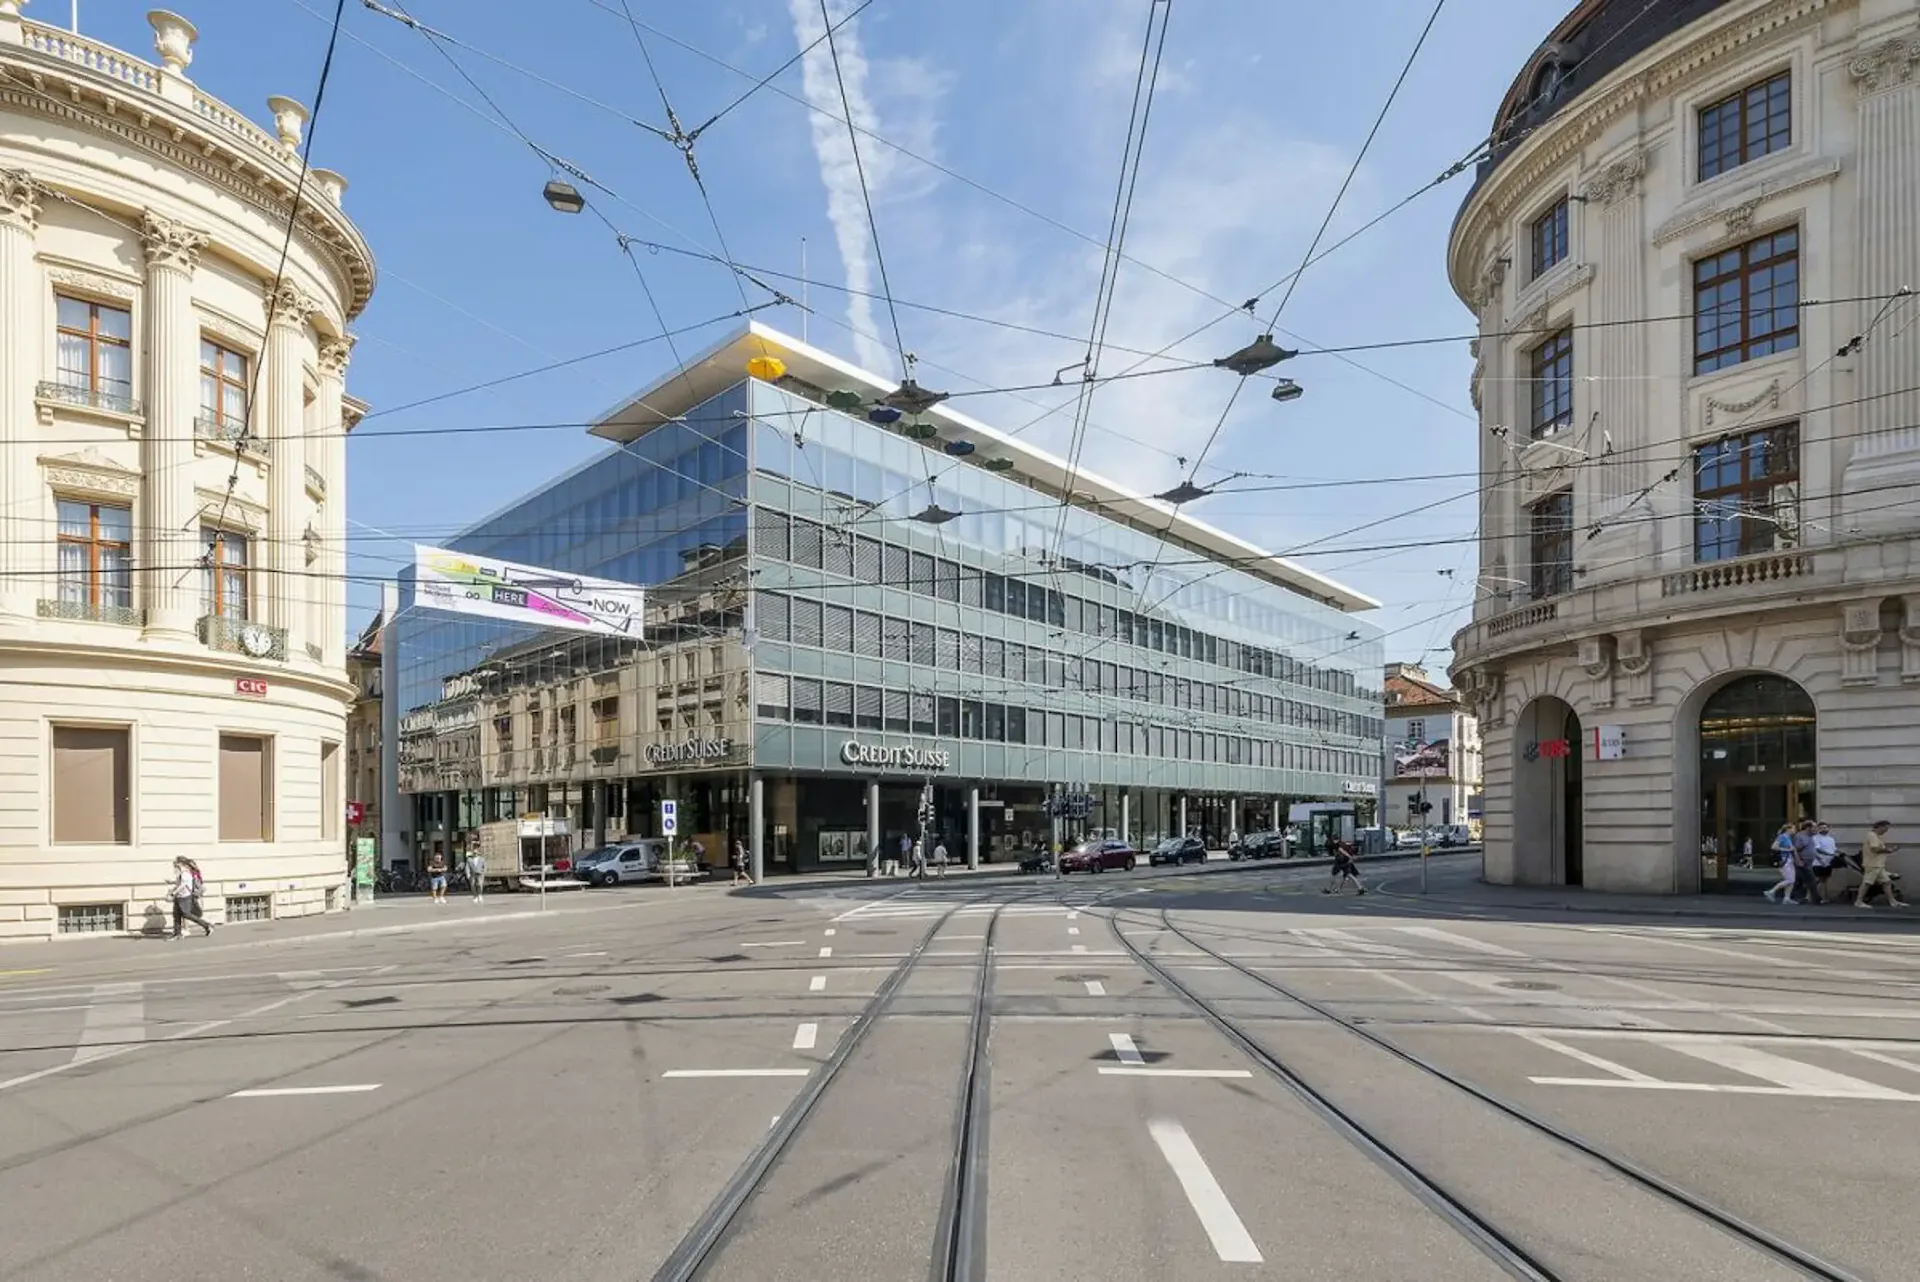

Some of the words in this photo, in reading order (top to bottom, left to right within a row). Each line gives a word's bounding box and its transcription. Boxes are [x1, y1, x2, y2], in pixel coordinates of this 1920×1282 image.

[494, 590, 525, 605] HERE
[593, 598, 631, 616] NOW
[239, 680, 267, 693] CIC
[644, 743, 684, 763] CREDIT
[686, 738, 729, 759] SUISSE
[844, 740, 903, 763] CREDIT
[904, 745, 950, 767] SUISSE
